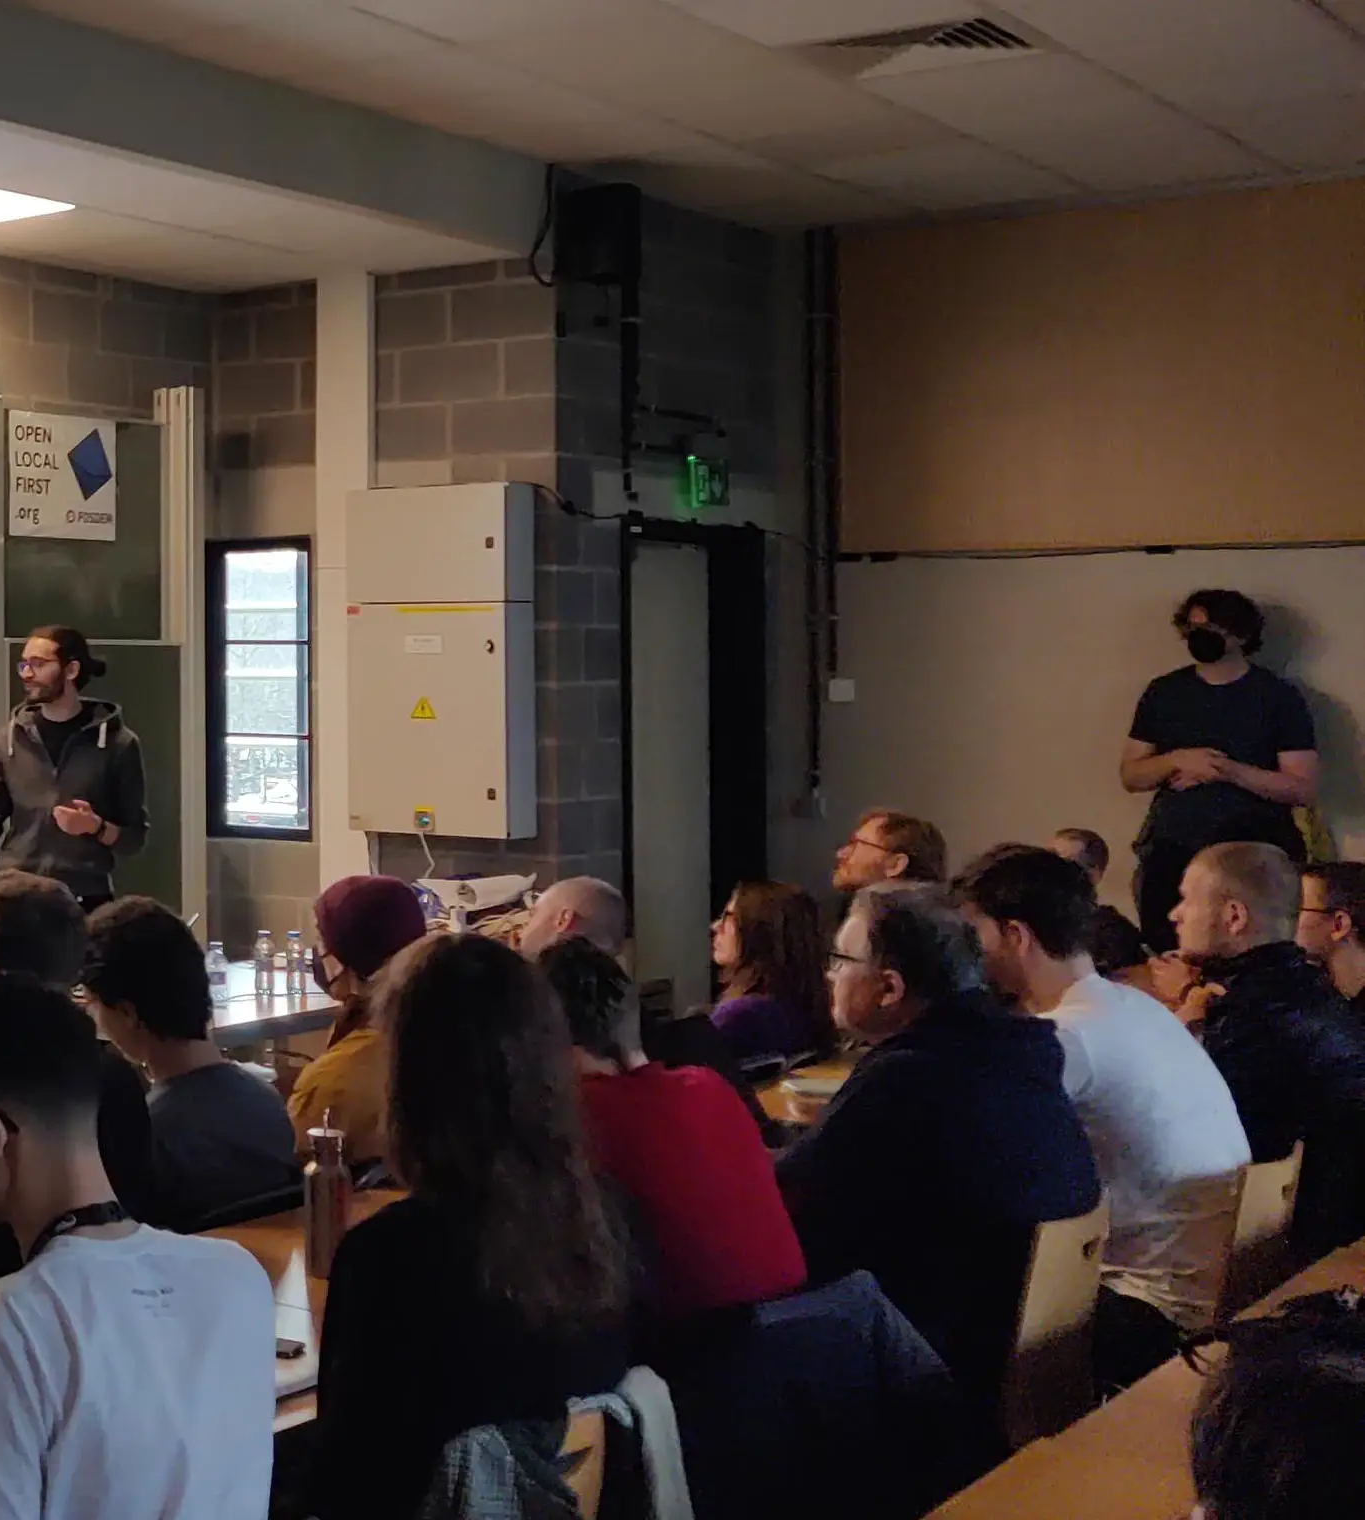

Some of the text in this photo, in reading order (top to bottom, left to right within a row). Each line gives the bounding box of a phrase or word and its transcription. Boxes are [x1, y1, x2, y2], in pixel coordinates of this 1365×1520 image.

[14, 424, 53, 444] OPEN
[15, 451, 60, 470] LOCAL
[15, 476, 52, 495] FIRST
[15, 507, 41, 525] .org
